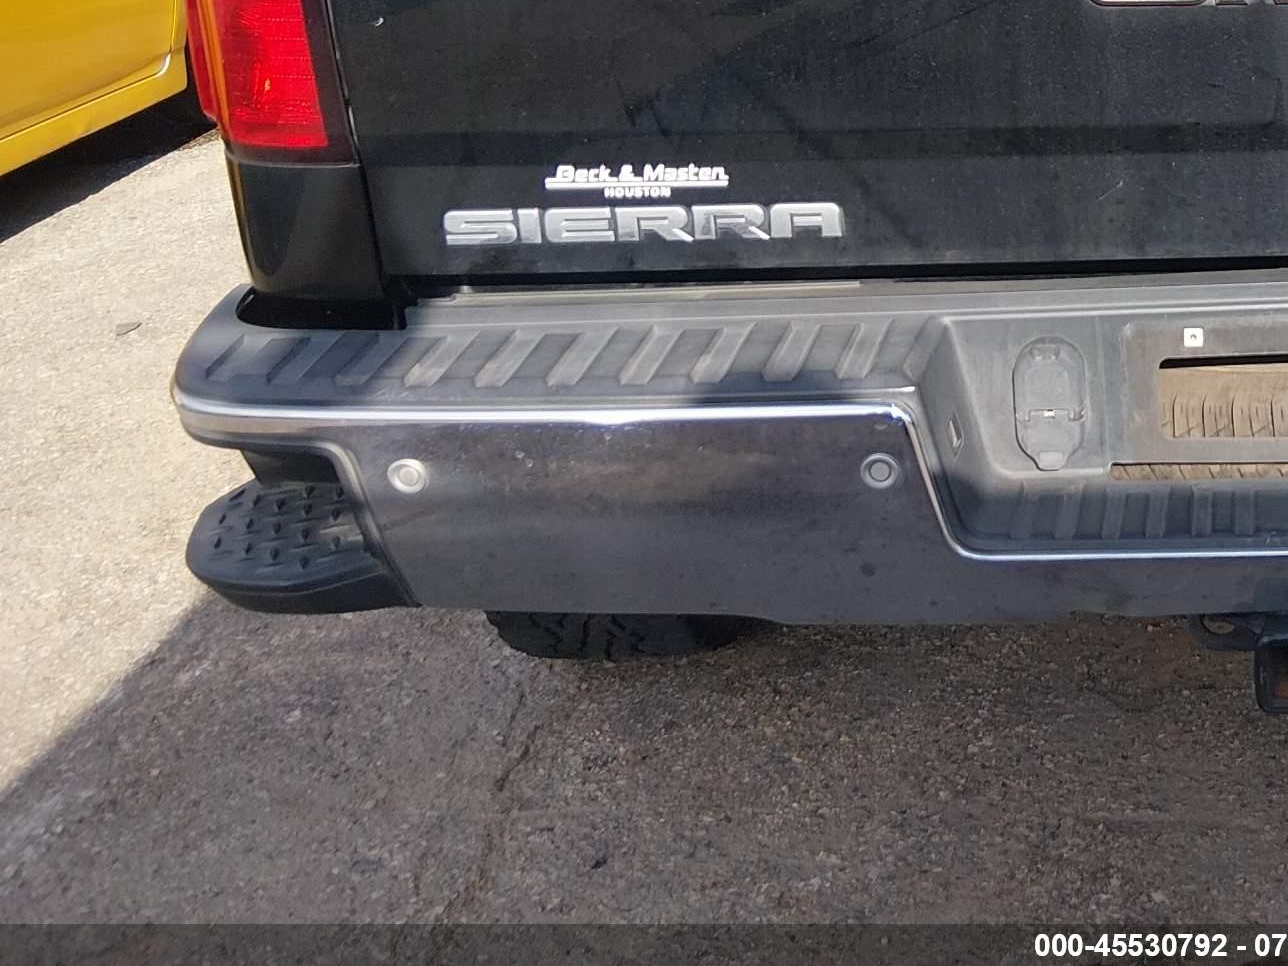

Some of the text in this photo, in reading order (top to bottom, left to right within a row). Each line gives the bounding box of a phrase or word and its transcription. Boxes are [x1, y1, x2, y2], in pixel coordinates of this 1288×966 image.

[550, 163, 729, 182] Beck & Masten
[604, 186, 672, 199] HOUSTON
[443, 202, 845, 245] SIERRA
